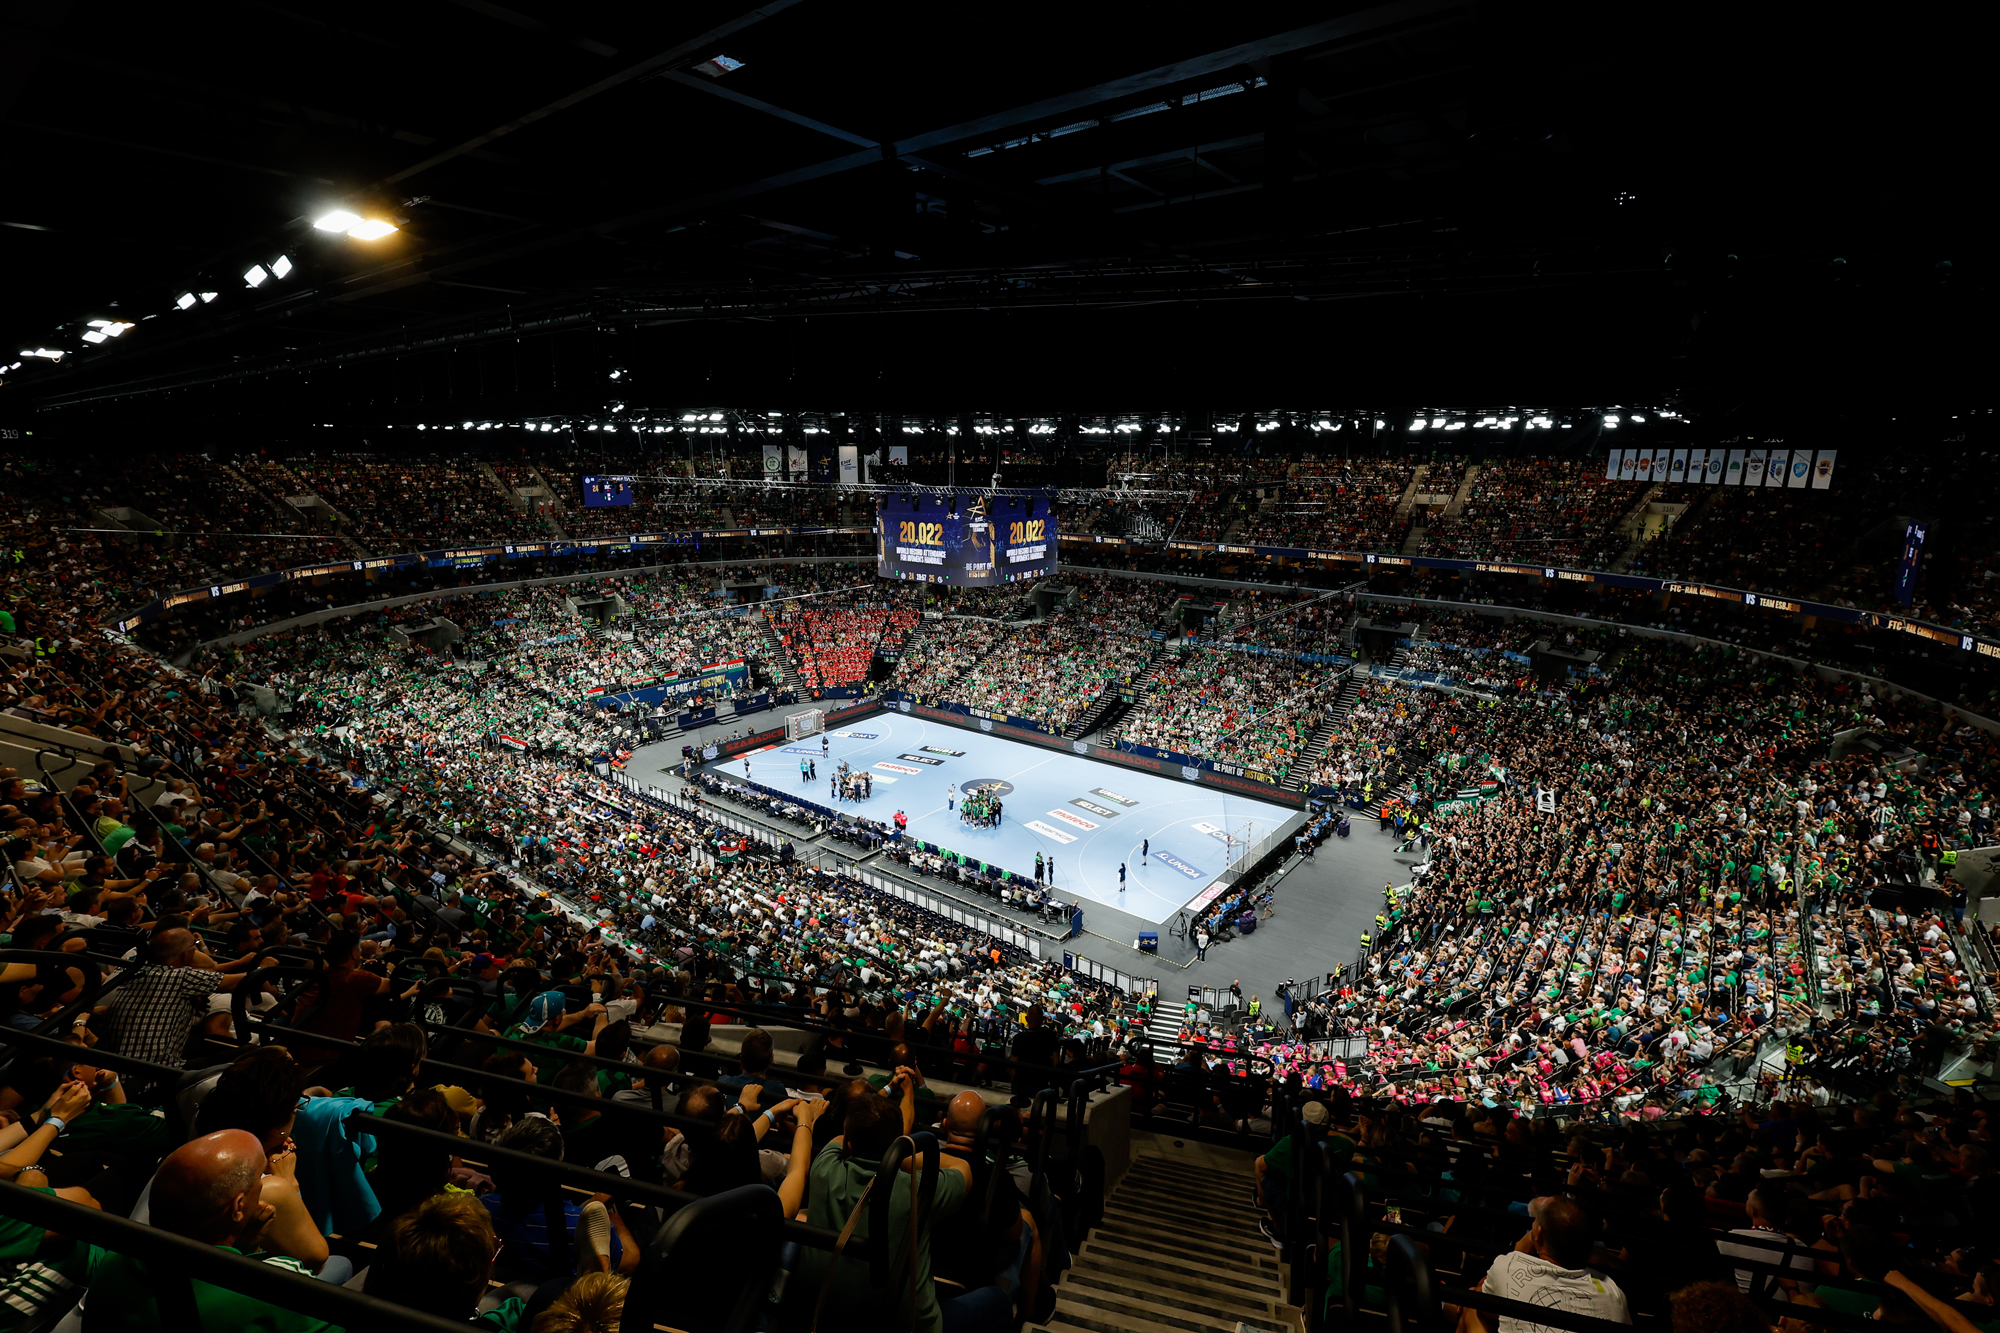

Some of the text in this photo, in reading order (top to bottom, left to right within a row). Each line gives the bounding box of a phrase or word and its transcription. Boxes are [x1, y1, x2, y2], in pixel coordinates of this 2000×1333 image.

[0, 428, 19, 439] 319
[900, 520, 944, 547] 20,022
[1010, 519, 1045, 545] 20,022
[505, 545, 513, 554] VS
[1218, 544, 1226, 552] VS
[354, 561, 362, 570] VS
[966, 562, 992, 571] BE PART OF
[1366, 554, 1375, 563] VS
[1476, 564, 1500, 573] FTC-RAIL
[1545, 568, 1554, 578] VS
[1558, 571, 1572, 580] TEAM
[210, 586, 220, 598] VS
[1669, 584, 1698, 595] FTC-RAIL
[1745, 593, 1756, 605] VS
[1759, 597, 1775, 609] TEAM
[1962, 635, 1973, 651] VS
[1976, 642, 1993, 656] TEAM
[666, 686, 676, 696] BE
[701, 674, 726, 688] HISTORY
[825, 703, 876, 721] WW.SZABADICS.HU
[916, 706, 965, 724] SZABADICS
[970, 707, 1008, 723] BE PART OF HISTORY
[725, 729, 784, 752] SZABADICS
[996, 725, 1066, 747] WWW.SZABADICS.HU
[926, 745, 963, 756] UNIBET
[1095, 748, 1161, 770] SZABADICS
[877, 763, 919, 774] mateco
[904, 755, 940, 765] SELECT
[1213, 762, 1269, 782] BE PART OF HISTORY
[1099, 788, 1136, 805] UNIBET
[1205, 774, 1302, 802] WWW.SZABADICS.HU
[1076, 800, 1113, 817] SELECT
[1053, 810, 1095, 829] mateco
[1212, 831, 1243, 845] OMV
[1166, 858, 1201, 879] UNIQA
